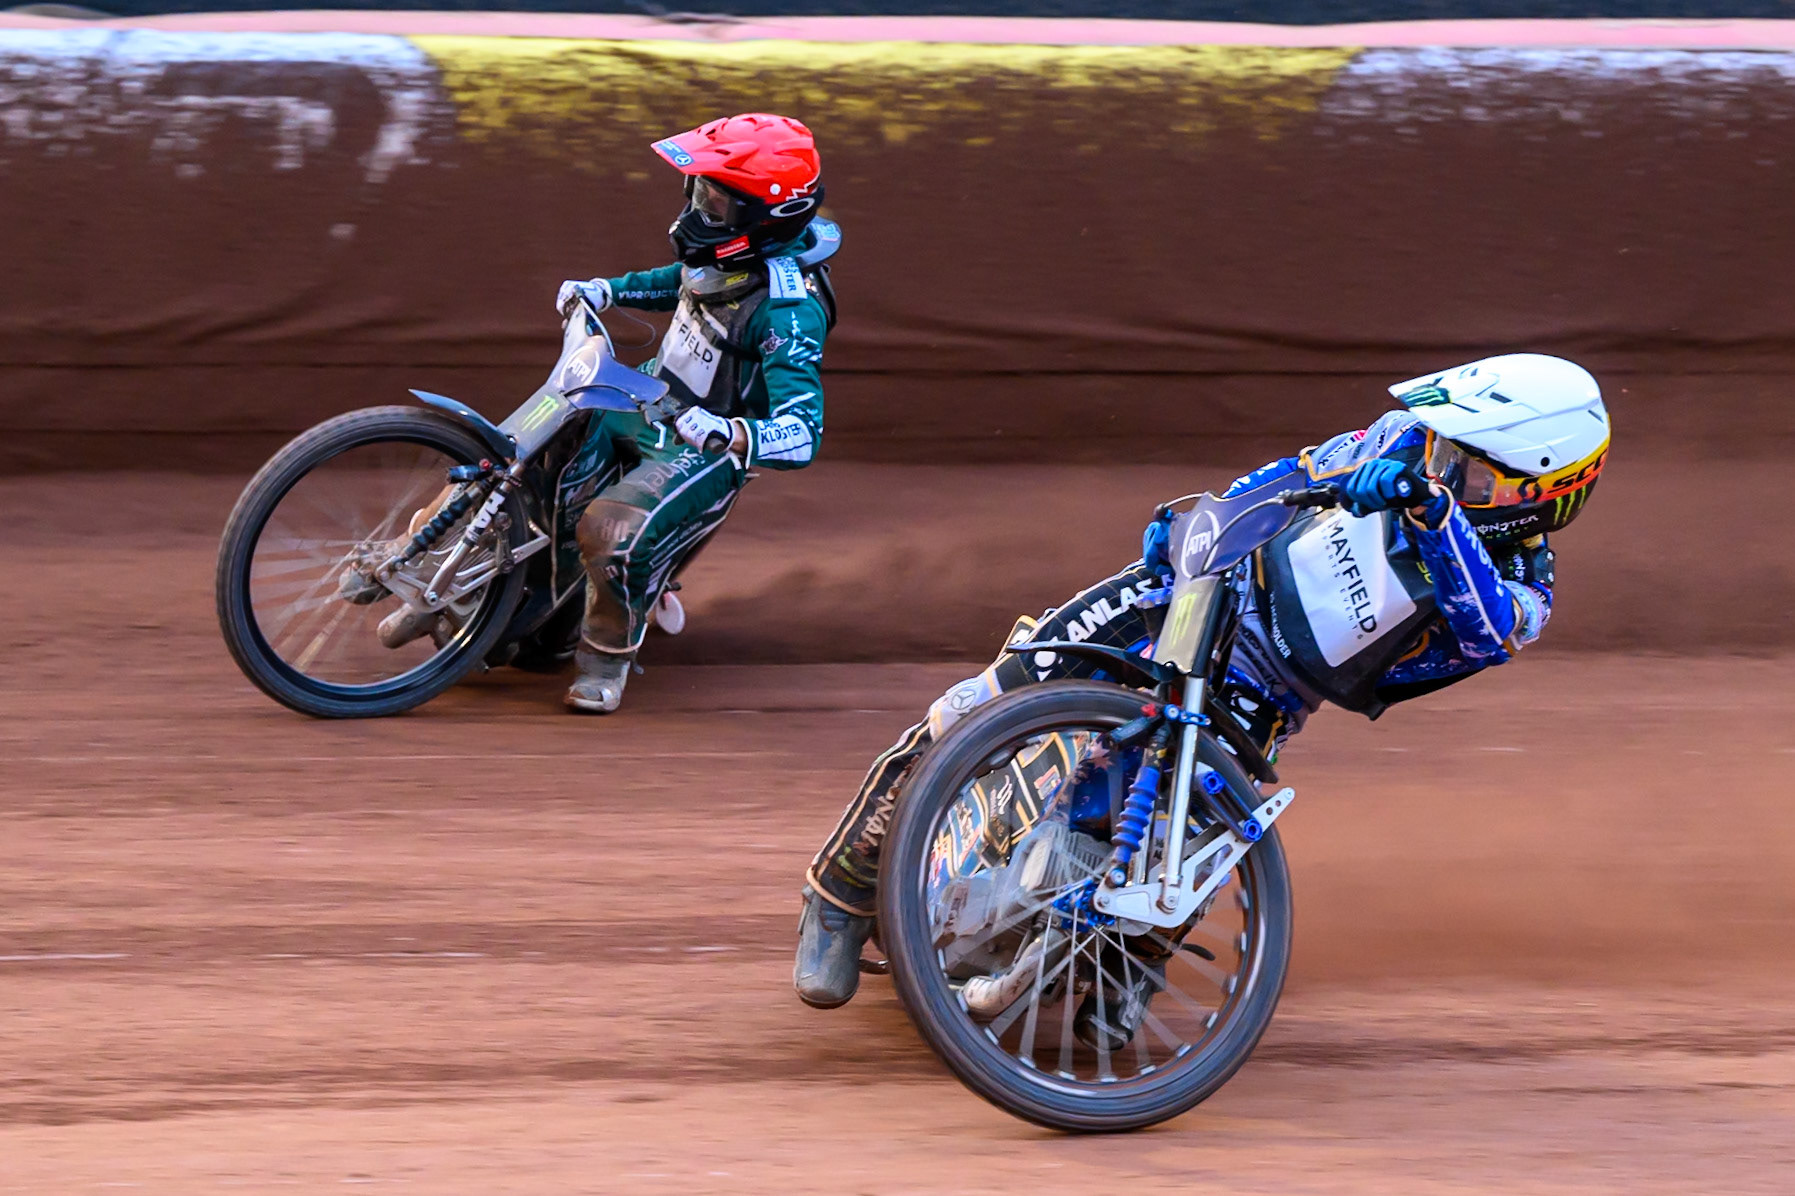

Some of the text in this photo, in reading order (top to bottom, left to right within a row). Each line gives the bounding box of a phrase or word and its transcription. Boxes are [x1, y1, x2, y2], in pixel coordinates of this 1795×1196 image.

[679, 323, 713, 363] FIELD
[1472, 515, 1539, 535] ONSTER
[1329, 519, 1377, 633] MAYFIELD
